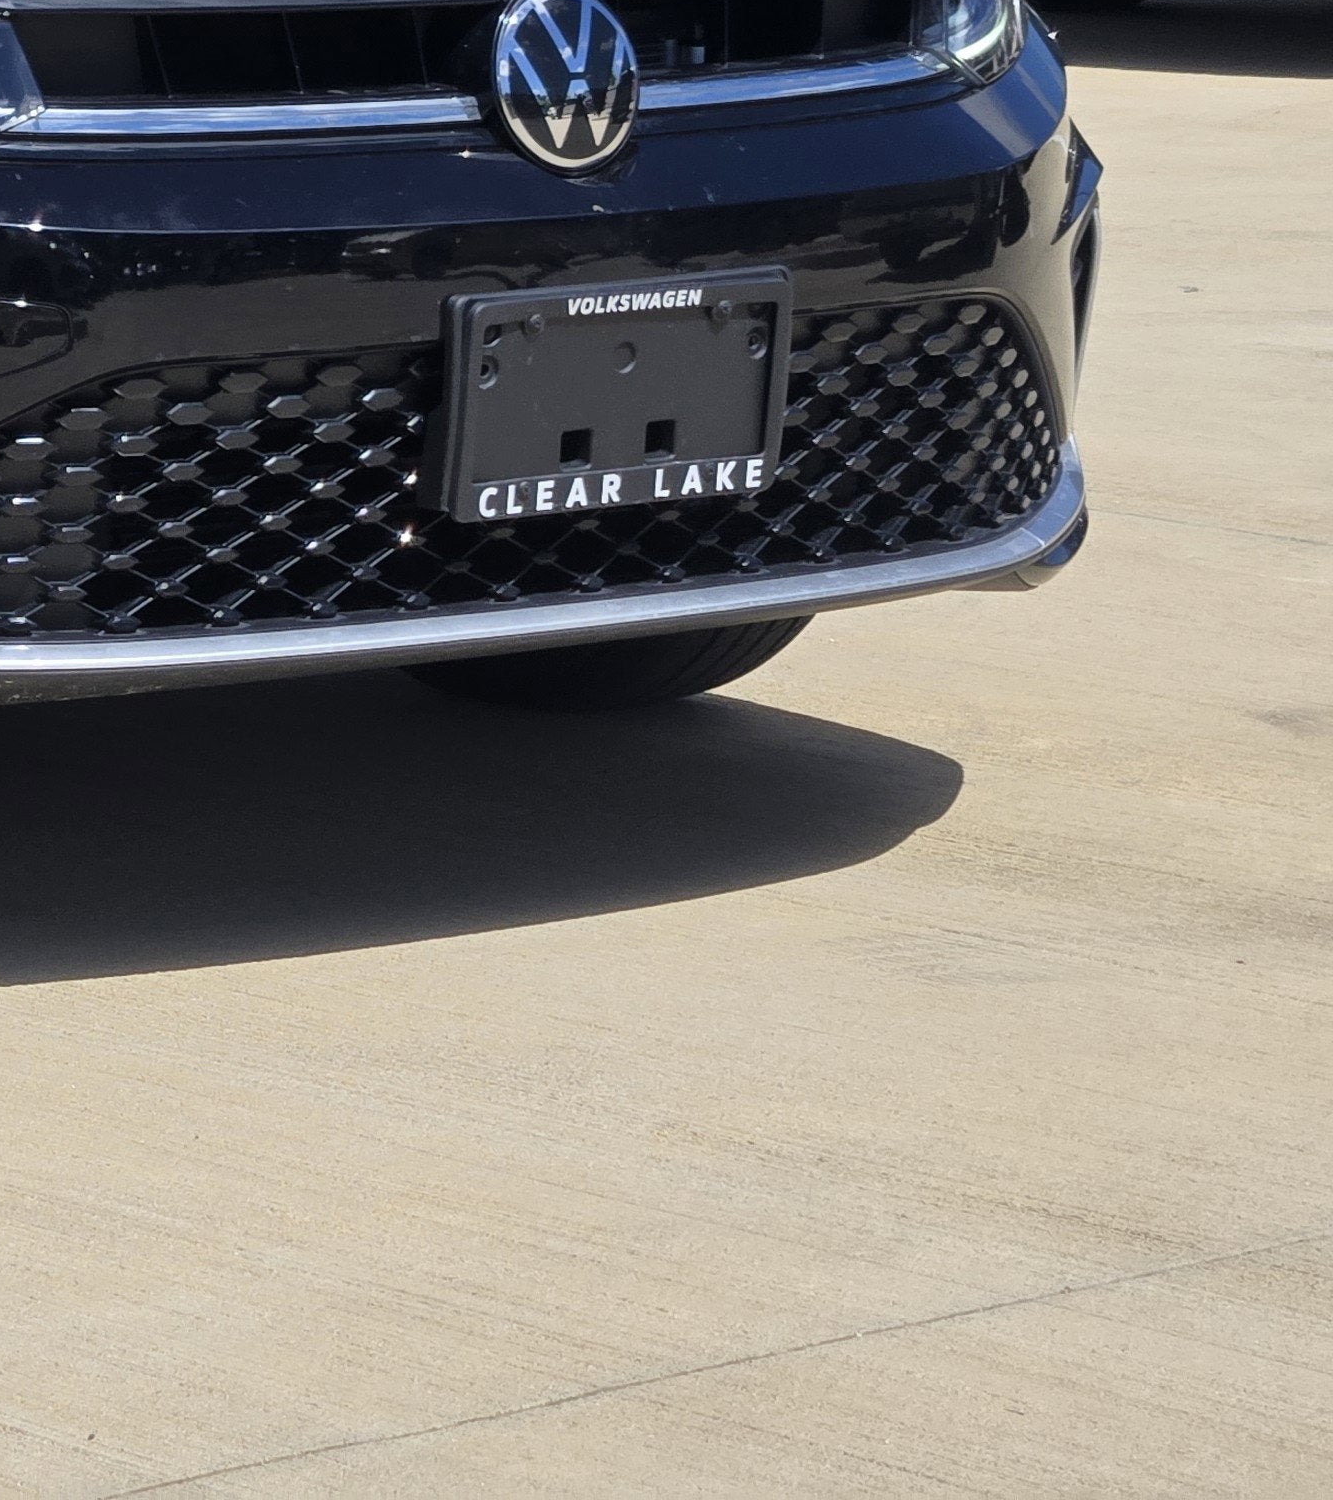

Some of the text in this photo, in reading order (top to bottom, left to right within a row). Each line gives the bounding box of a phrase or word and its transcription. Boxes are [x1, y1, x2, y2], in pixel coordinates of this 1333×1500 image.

[568, 289, 702, 315] VOLKSWAGEN
[479, 459, 764, 518] CLEAR LAKE
